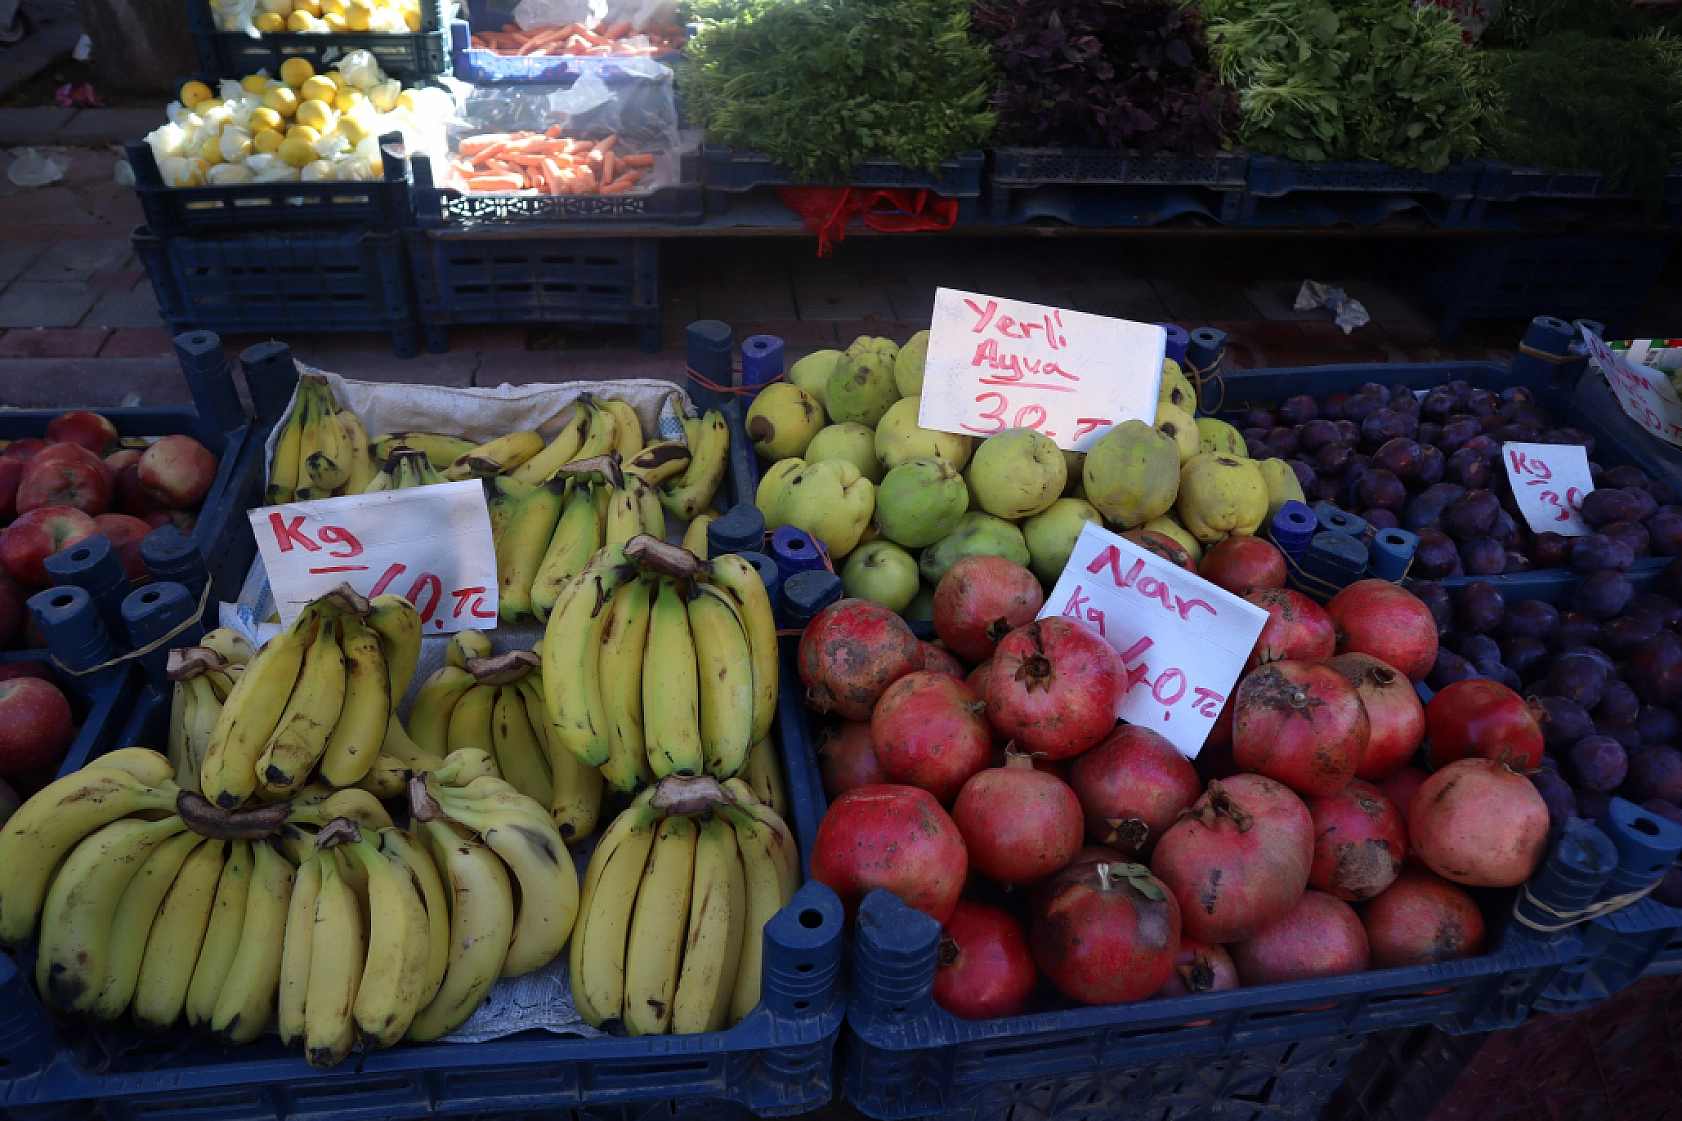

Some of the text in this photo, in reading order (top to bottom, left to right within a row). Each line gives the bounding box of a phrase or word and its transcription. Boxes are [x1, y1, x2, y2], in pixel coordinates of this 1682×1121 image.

[971, 338, 1080, 382] Ayva
[1509, 450, 1553, 479] Kg
[268, 512, 364, 557] Kg
[1086, 545, 1218, 621] Nar
